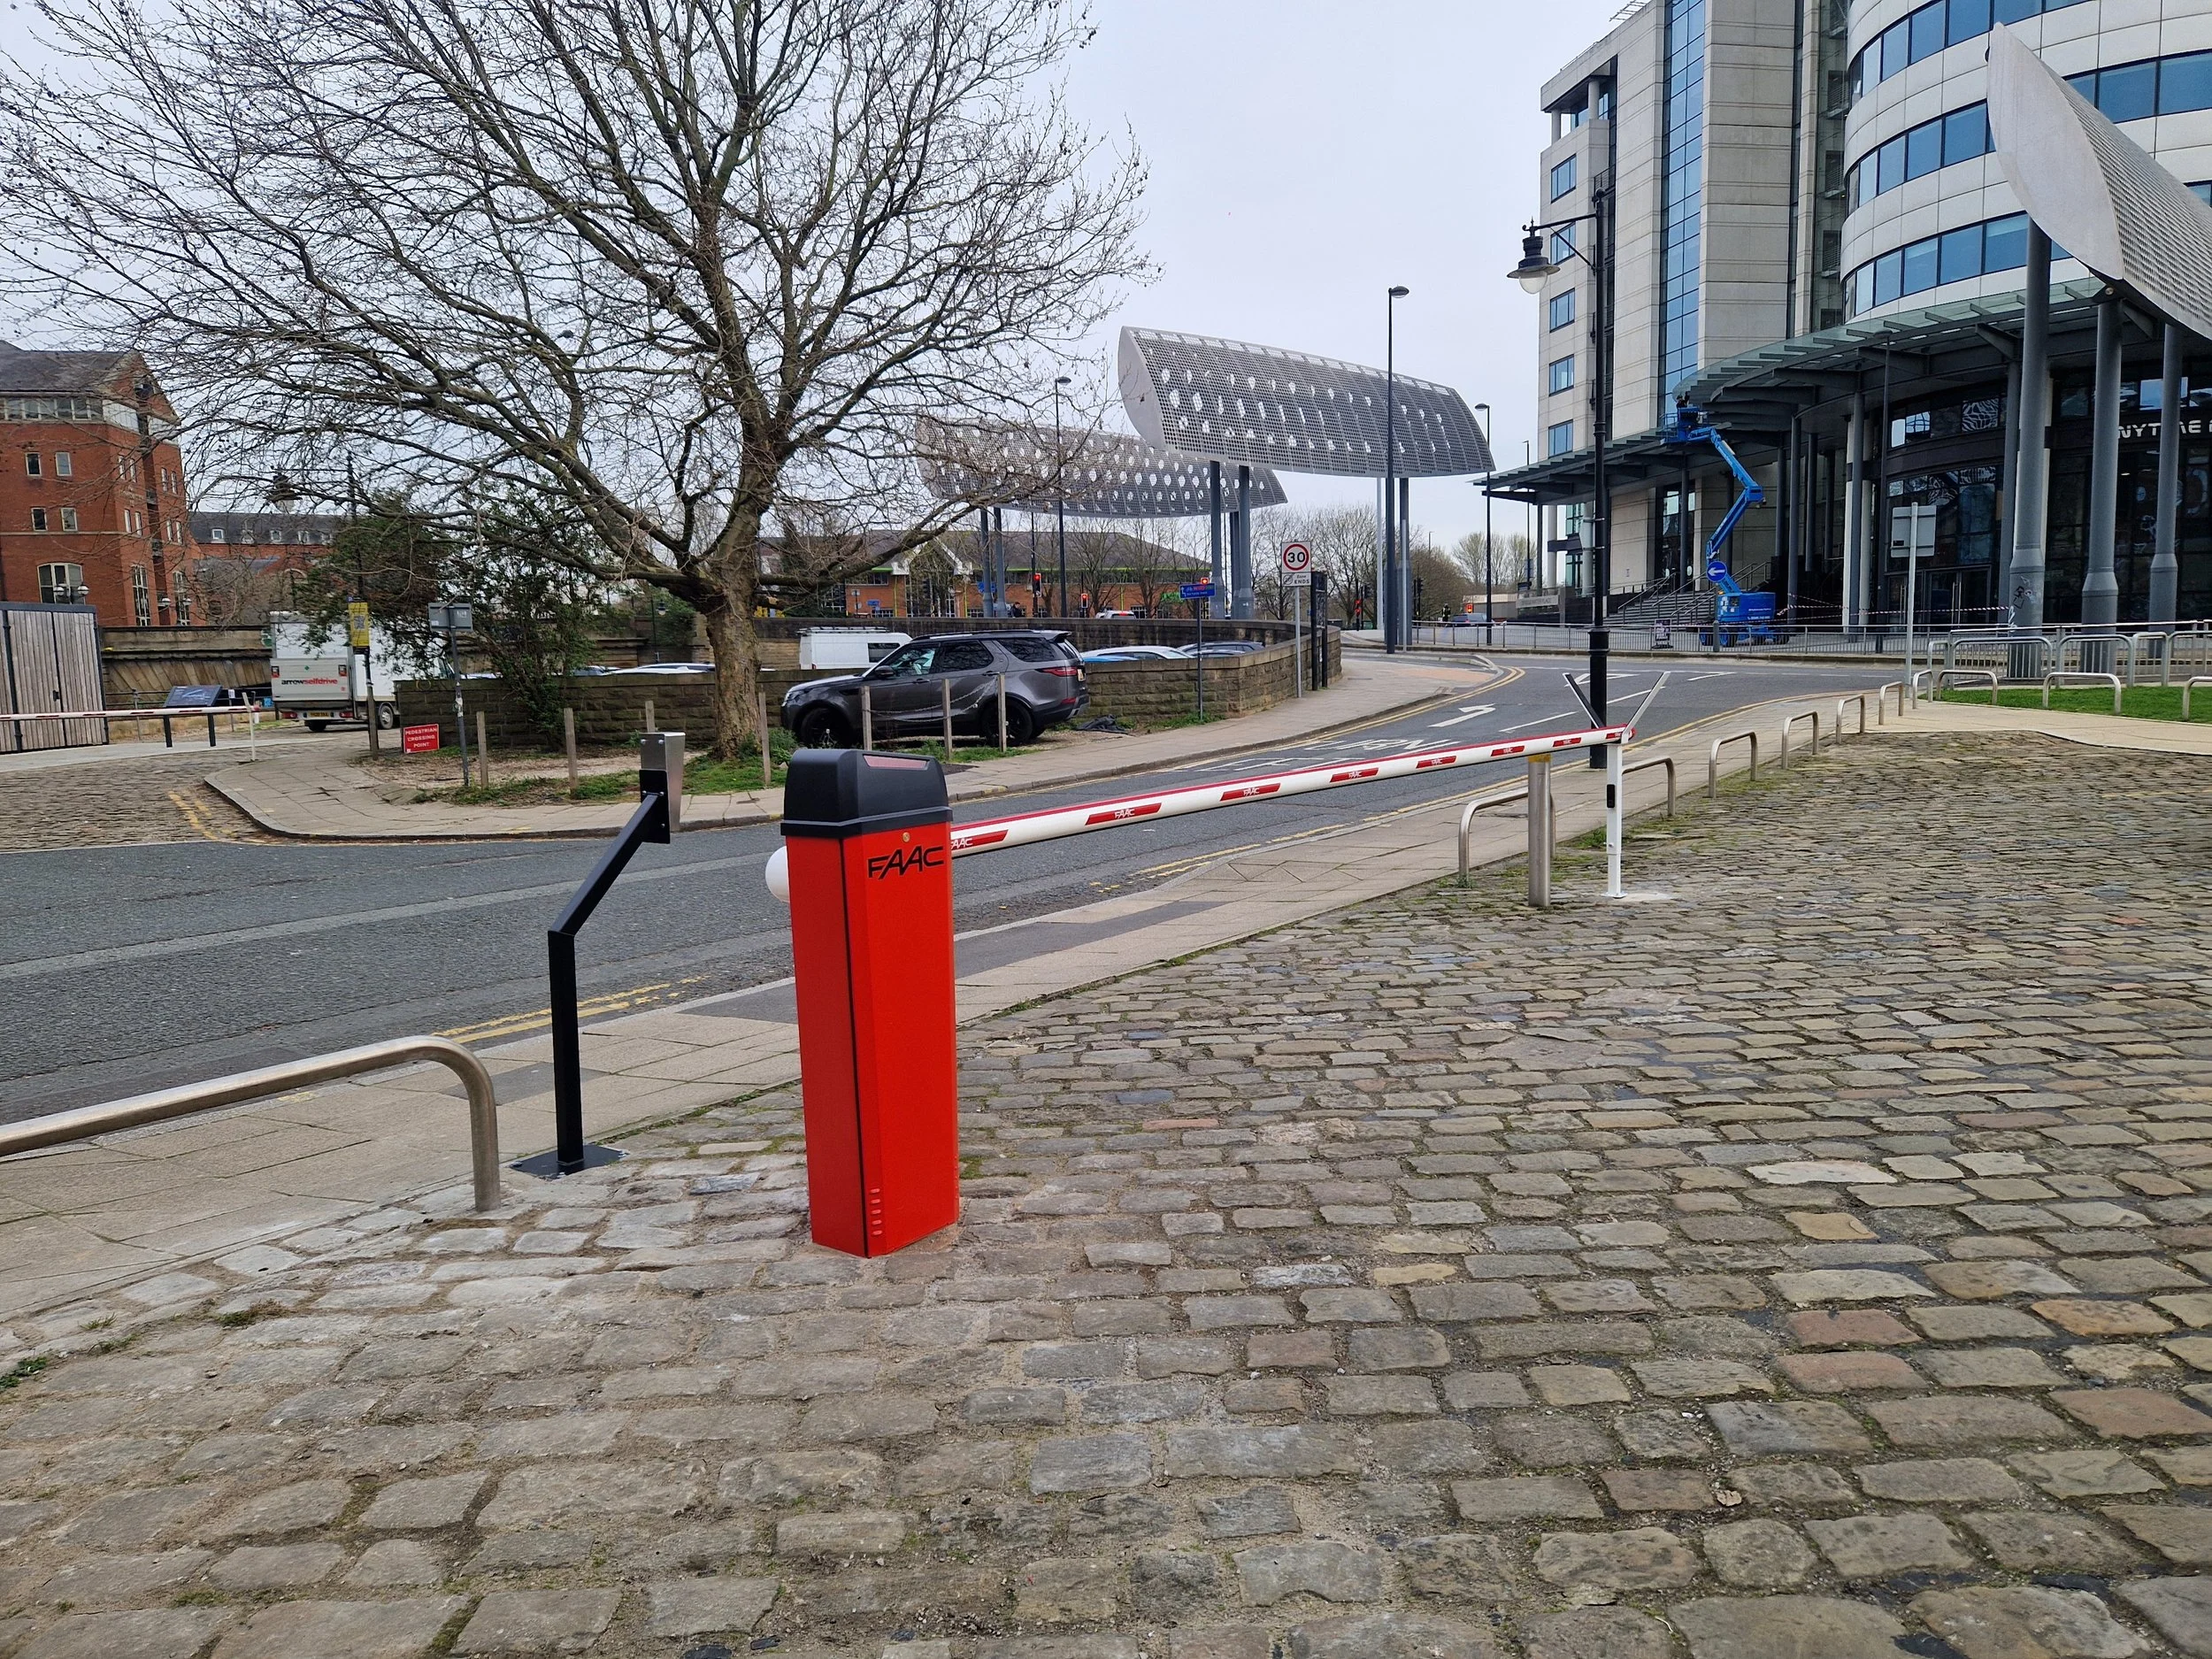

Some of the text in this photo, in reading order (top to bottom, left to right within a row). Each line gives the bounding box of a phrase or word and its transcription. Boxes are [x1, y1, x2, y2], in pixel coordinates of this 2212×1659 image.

[1287, 552, 1305, 563] 30
[1114, 809, 1135, 819] FAAC
[867, 845, 944, 879] FAAC
